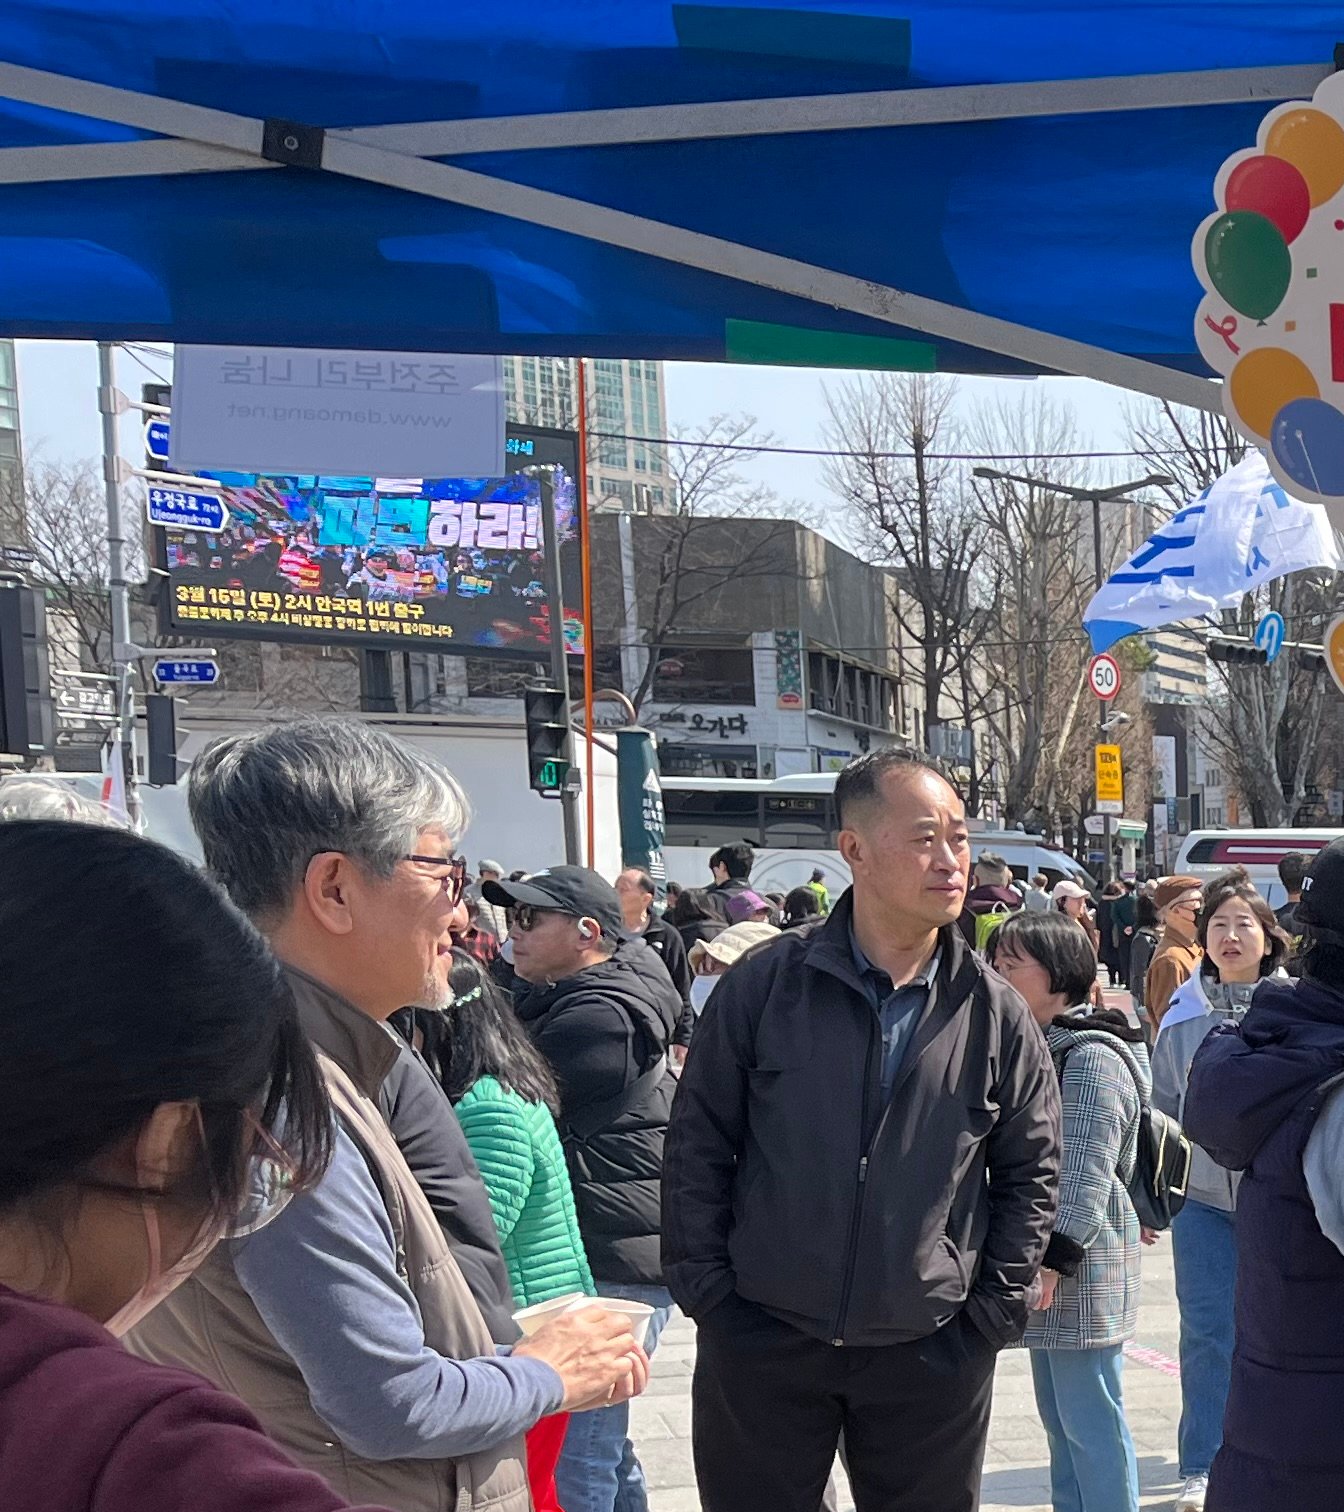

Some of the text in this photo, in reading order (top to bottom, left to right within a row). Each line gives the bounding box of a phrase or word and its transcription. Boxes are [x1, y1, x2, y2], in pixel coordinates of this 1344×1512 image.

[151, 490, 199, 511] 우정국로
[285, 592, 312, 612] 2시
[1095, 667, 1114, 687] 50
[688, 713, 748, 739] 오가다
